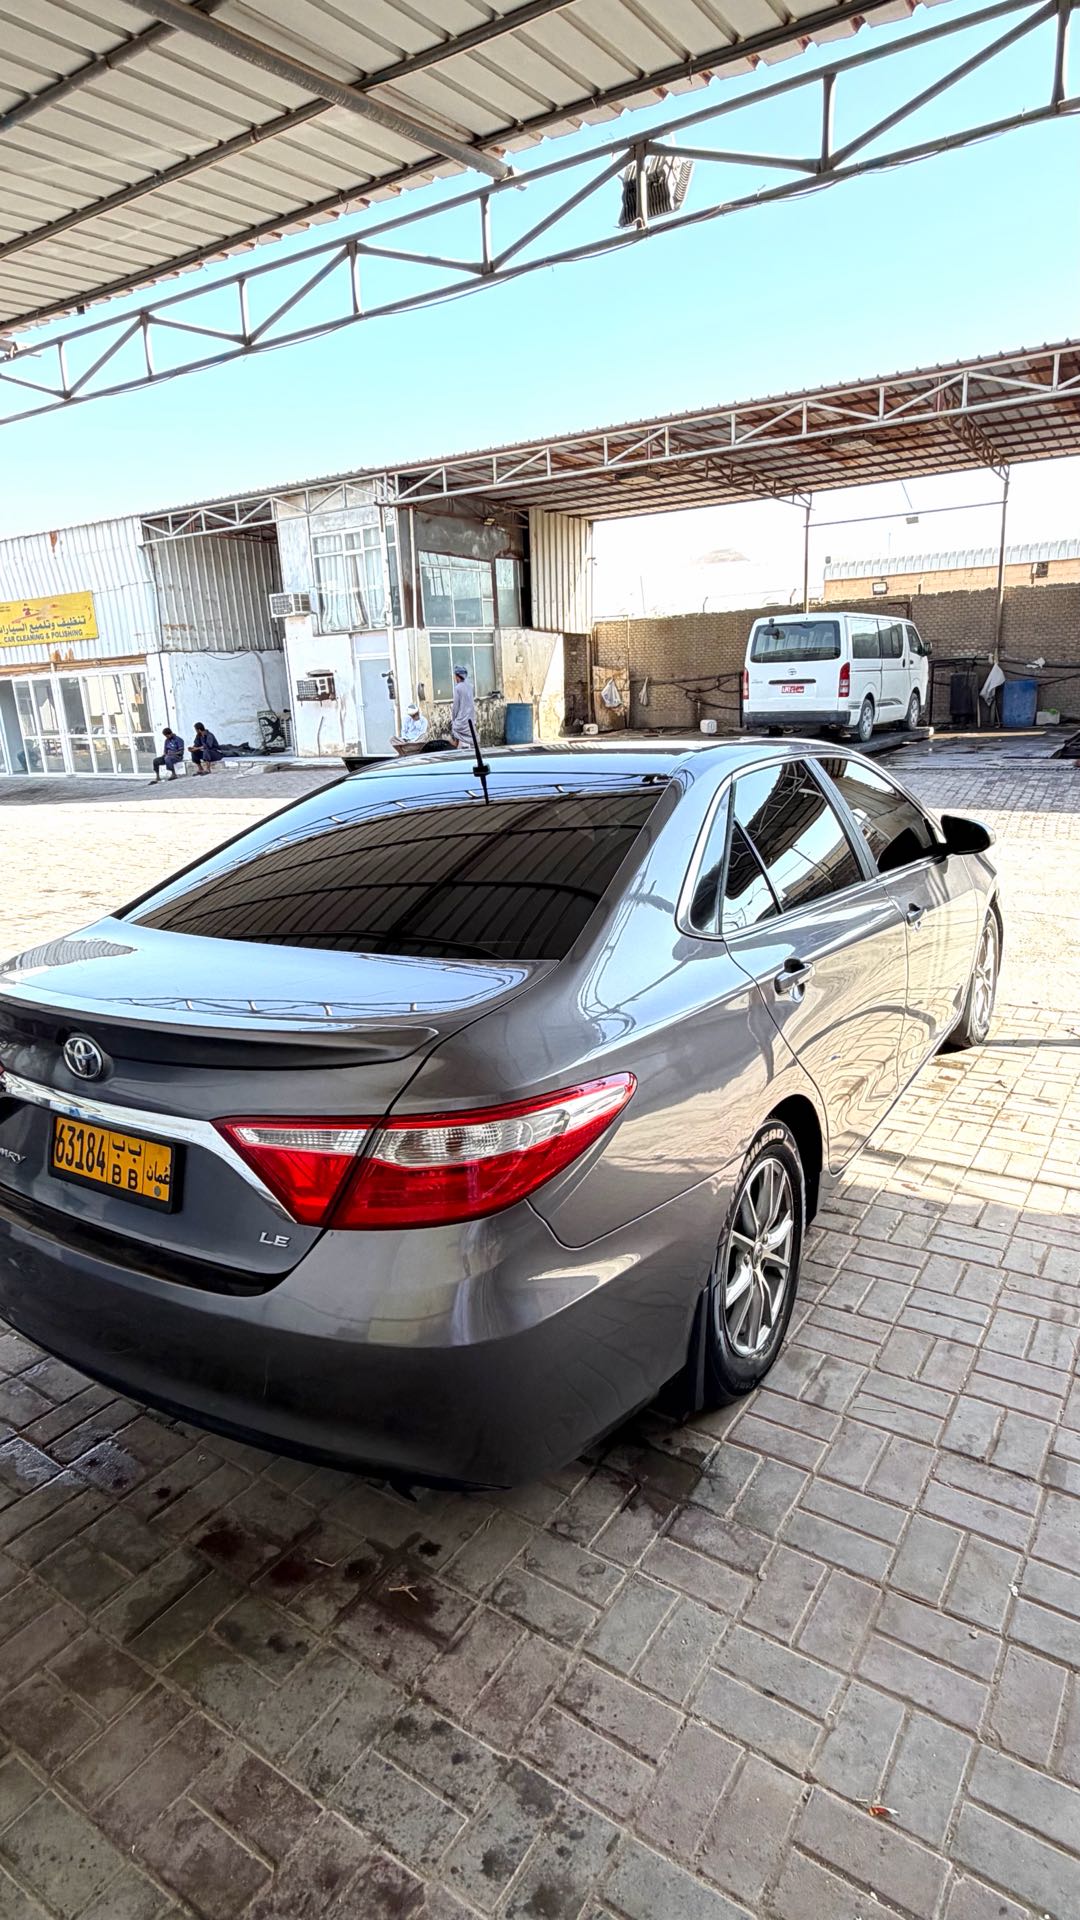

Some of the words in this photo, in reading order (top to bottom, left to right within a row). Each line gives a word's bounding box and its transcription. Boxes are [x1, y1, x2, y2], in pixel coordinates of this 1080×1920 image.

[57, 615, 86, 628] تنظيف
[16, 633, 45, 642] CLEANING
[51, 629, 83, 639] POLISHING
[55, 1123, 106, 1177] 63184
[259, 1231, 290, 1248] LE
